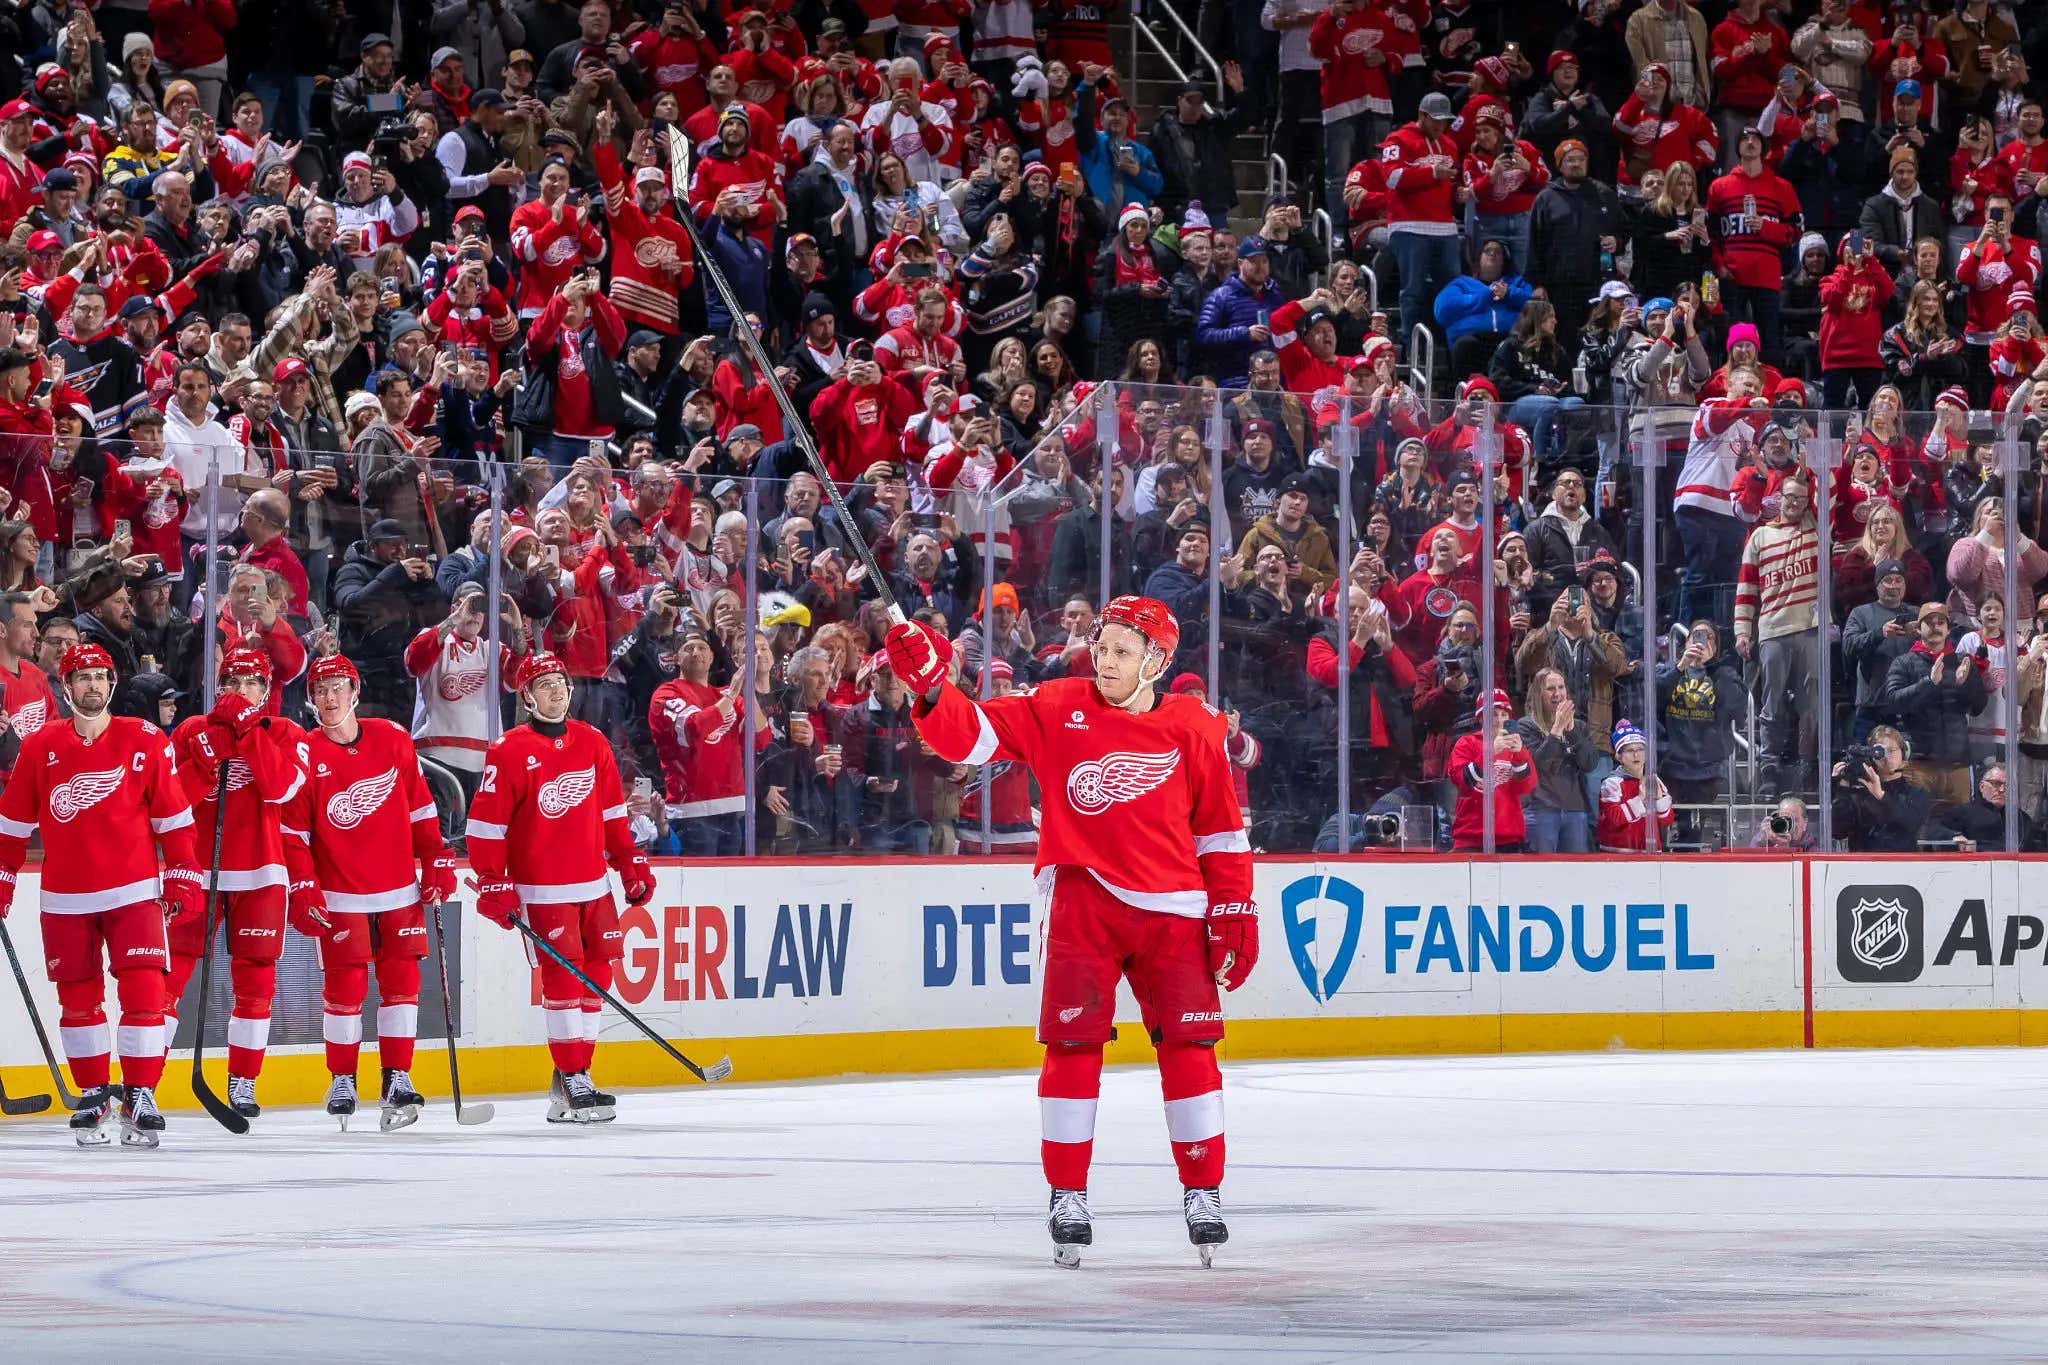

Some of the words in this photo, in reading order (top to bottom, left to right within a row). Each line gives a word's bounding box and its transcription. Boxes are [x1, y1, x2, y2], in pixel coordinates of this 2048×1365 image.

[1764, 557, 1813, 589] DETROIT
[1064, 722, 1090, 731] PRIORITY
[132, 752, 146, 772] C
[479, 764, 498, 793] 2
[433, 858, 456, 868] CC
[163, 868, 204, 884] WARRIO
[481, 883, 515, 893] CCM
[238, 928, 277, 937] CCM
[398, 927, 427, 937] CCM
[1384, 903, 1715, 974] FANDUEL
[1864, 916, 1897, 953] NHL
[531, 902, 853, 1005] GERLAW
[923, 903, 1031, 987] DTE
